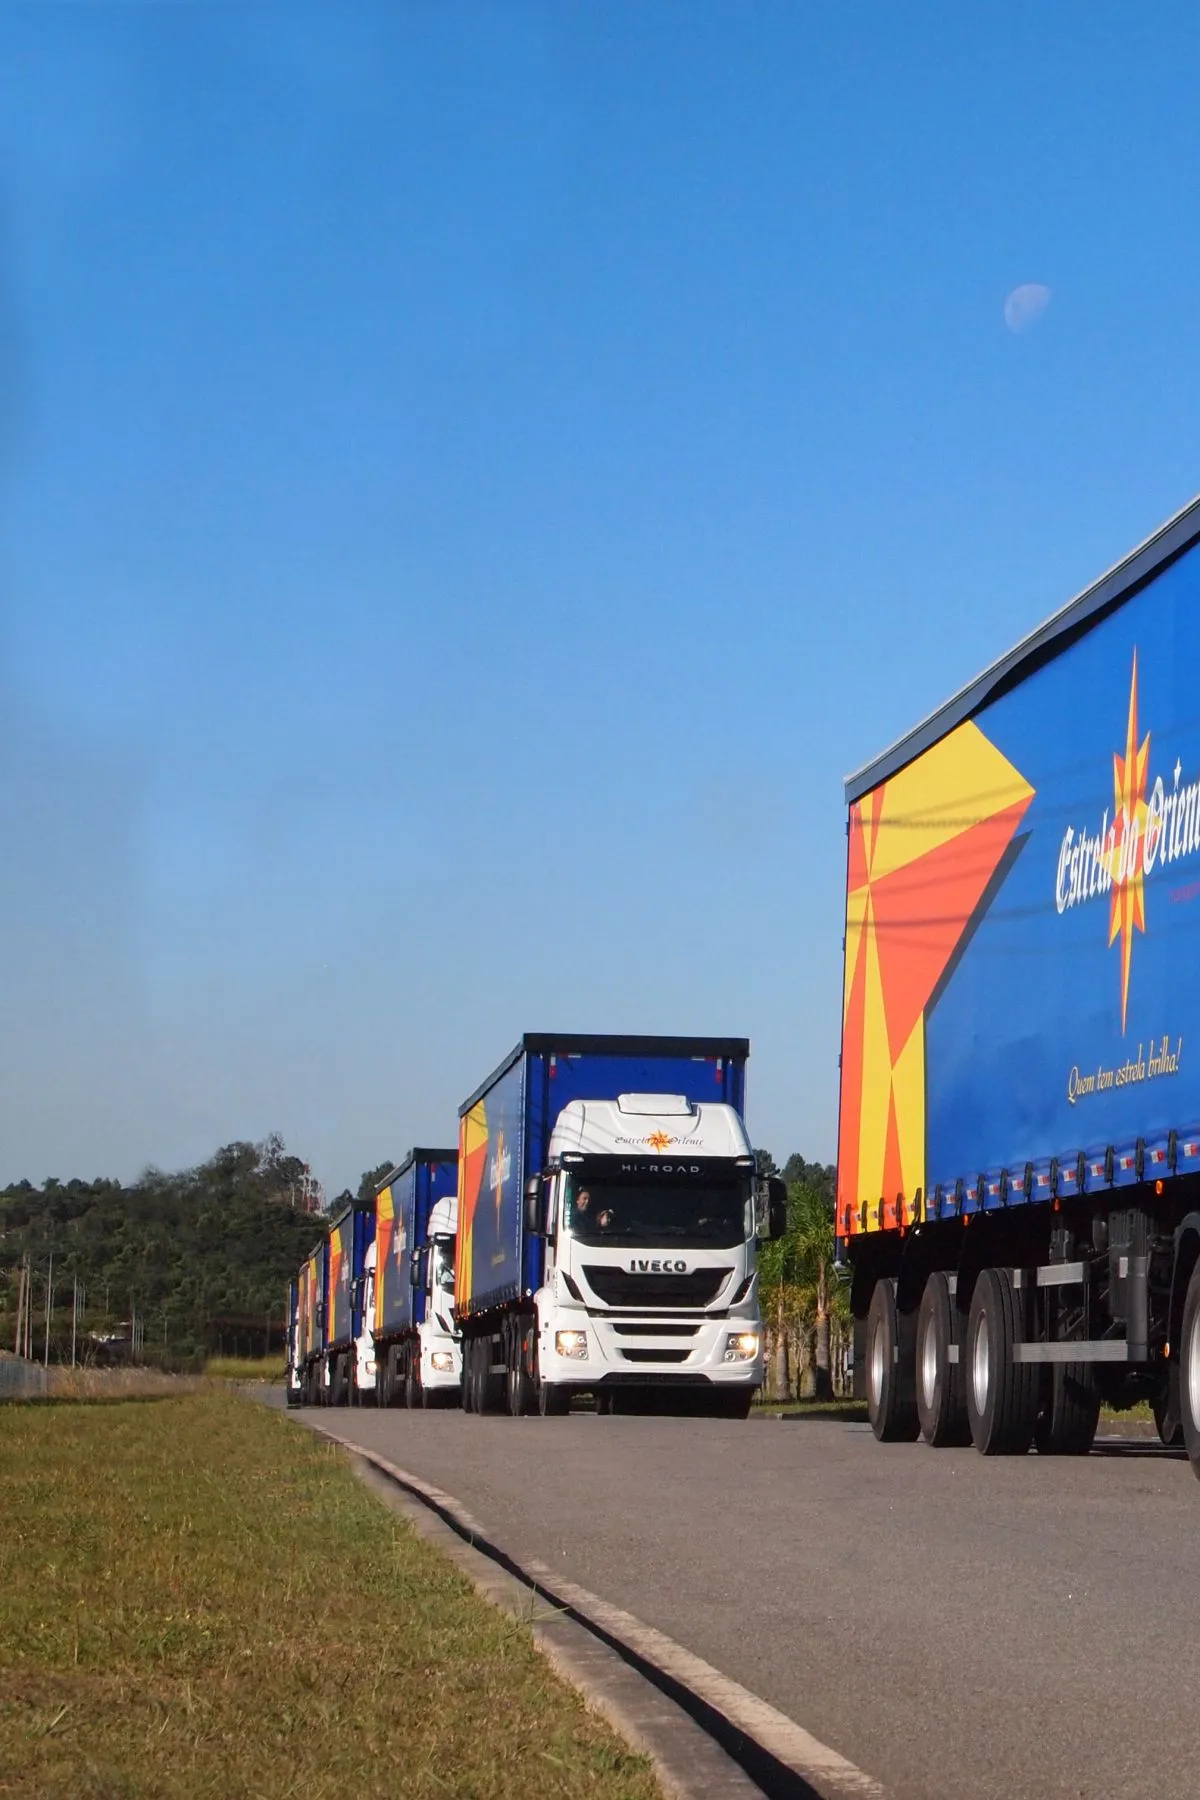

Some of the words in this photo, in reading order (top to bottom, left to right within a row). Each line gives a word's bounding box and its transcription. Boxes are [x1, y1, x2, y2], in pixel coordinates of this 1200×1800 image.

[1056, 807, 1115, 914] Estrela
[1068, 1066, 1095, 1104] Quem
[1097, 1065, 1114, 1090] tem
[1115, 1042, 1146, 1086] estrela
[1147, 1035, 1183, 1078] brilha!
[621, 1163, 700, 1173] HI-ROAD
[630, 1259, 687, 1273] IVECO
